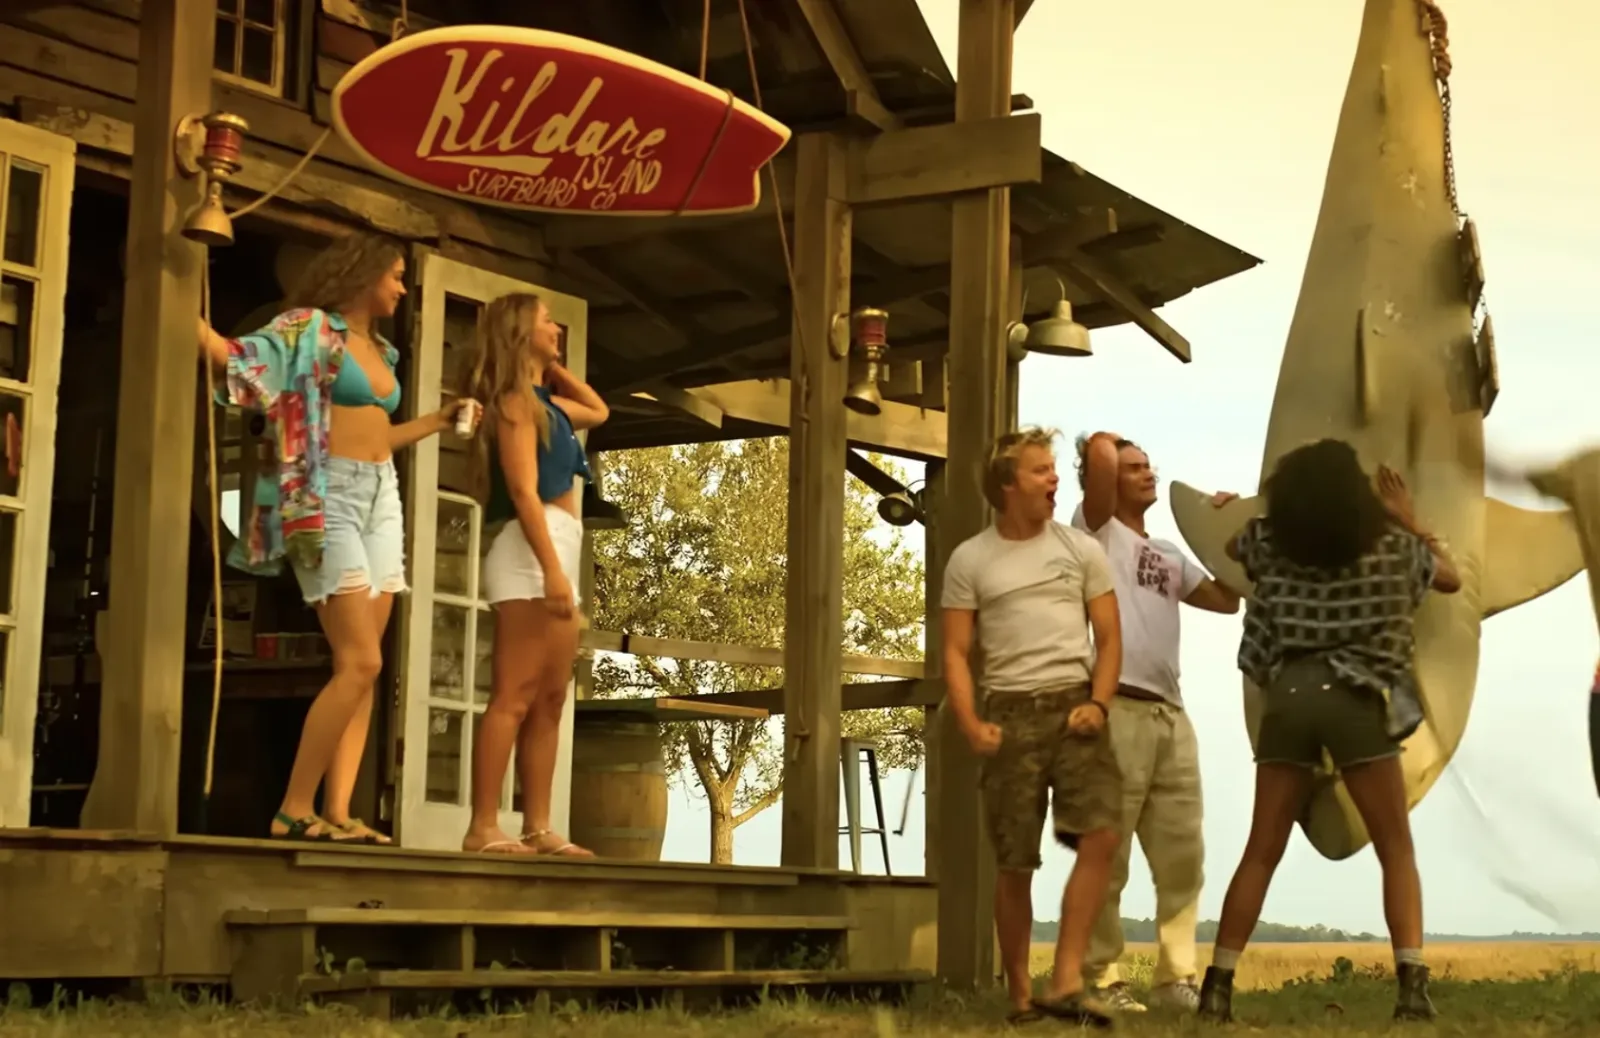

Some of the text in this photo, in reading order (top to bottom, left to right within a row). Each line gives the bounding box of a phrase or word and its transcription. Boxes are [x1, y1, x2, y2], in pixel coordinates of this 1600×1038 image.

[416, 48, 667, 159] Kildare
[457, 168, 617, 210] SURFBOARD CO
[573, 156, 662, 195] ISLAND
